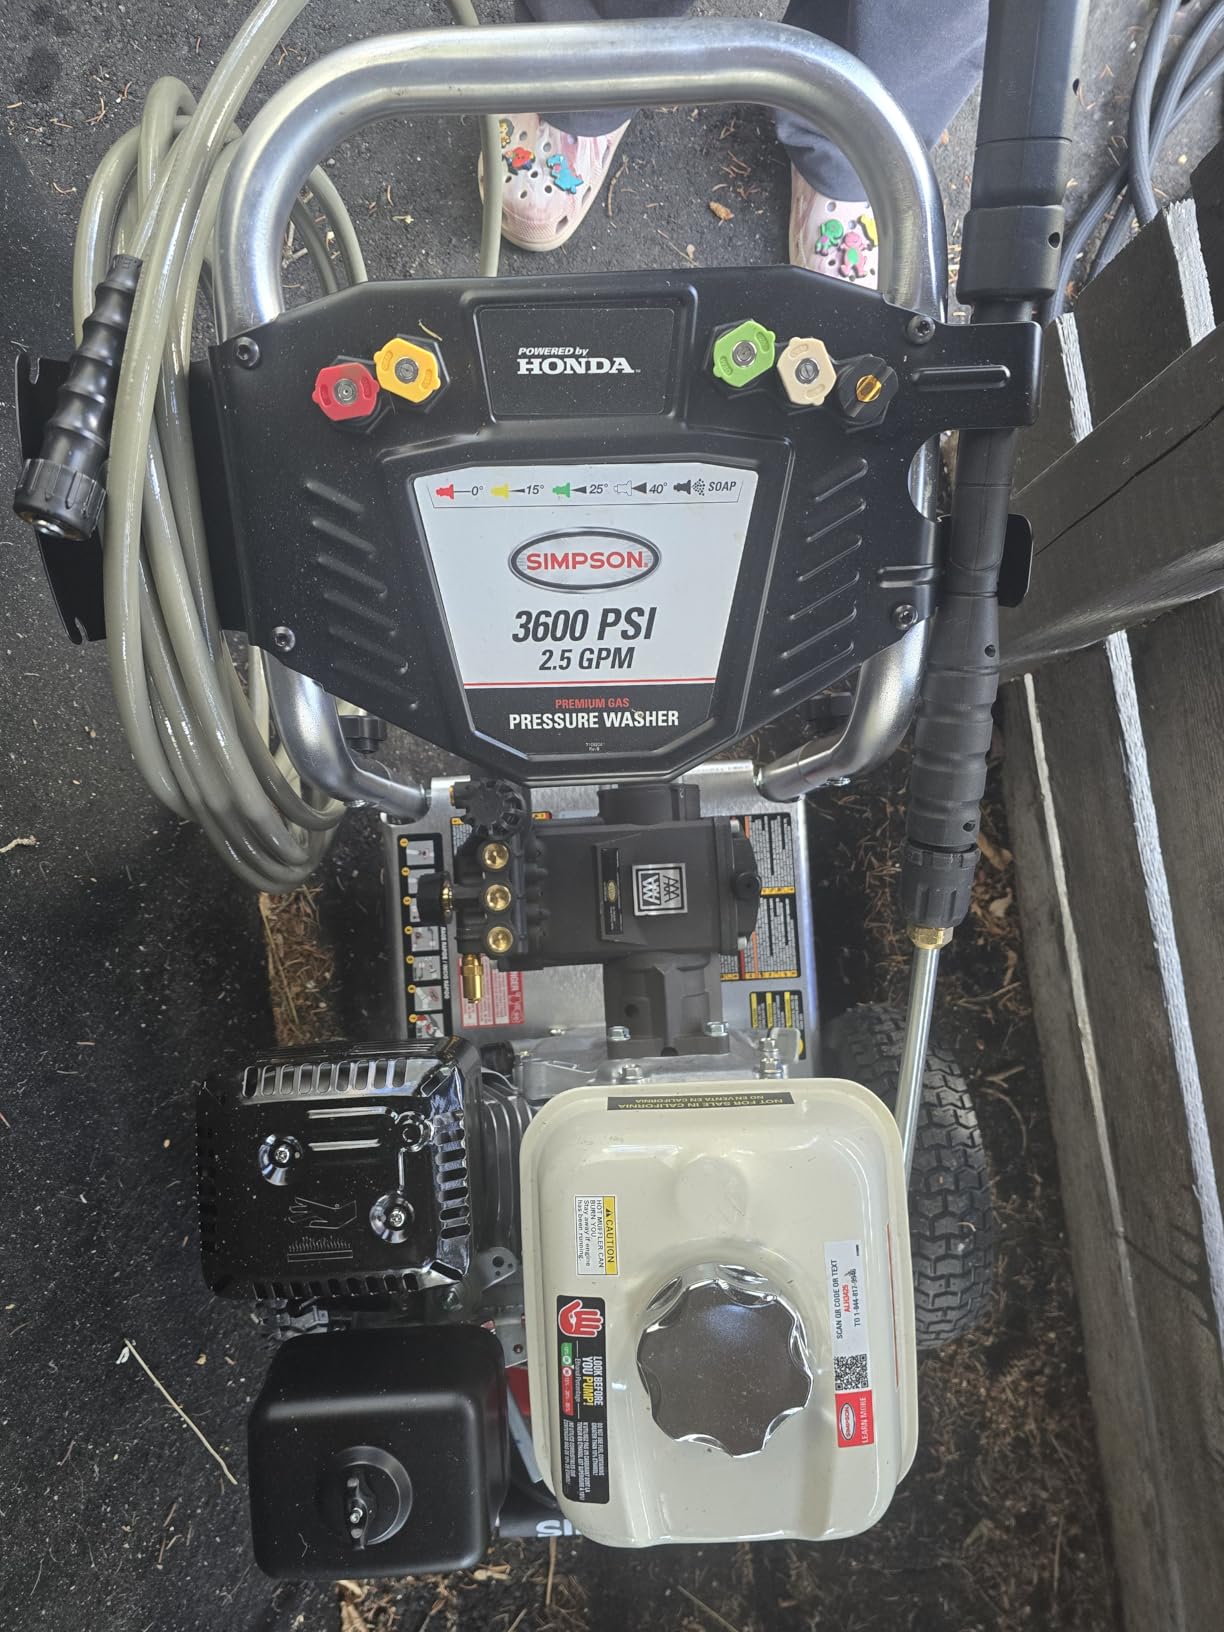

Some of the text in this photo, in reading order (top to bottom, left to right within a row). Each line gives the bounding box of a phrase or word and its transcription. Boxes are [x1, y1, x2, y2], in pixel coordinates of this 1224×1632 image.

[518, 346, 589, 356] POWERED by
[516, 358, 634, 374] HONDA
[526, 484, 545, 495] 15°
[588, 484, 608, 494] 25°
[649, 482, 668, 494] 40°
[708, 480, 737, 492] SOAP
[526, 551, 643, 571] SIMPSON
[512, 606, 658, 643] 3600 PSI
[538, 646, 636, 671] 2.5 GPM
[556, 698, 630, 710] PREMIUM GAS
[509, 710, 679, 730] PRESSURE WASHER
[606, 1220, 614, 1262] CAUTION
[833, 1278, 839, 1287] OR
[835, 1308, 841, 1318] QR
[854, 1318, 860, 1326] TO
[582, 1356, 593, 1406] YOU PUMP!
[594, 1356, 603, 1406] LOOK BEFORE
[860, 1418, 868, 1443] LEARN
[536, 1519, 582, 1538] SI
